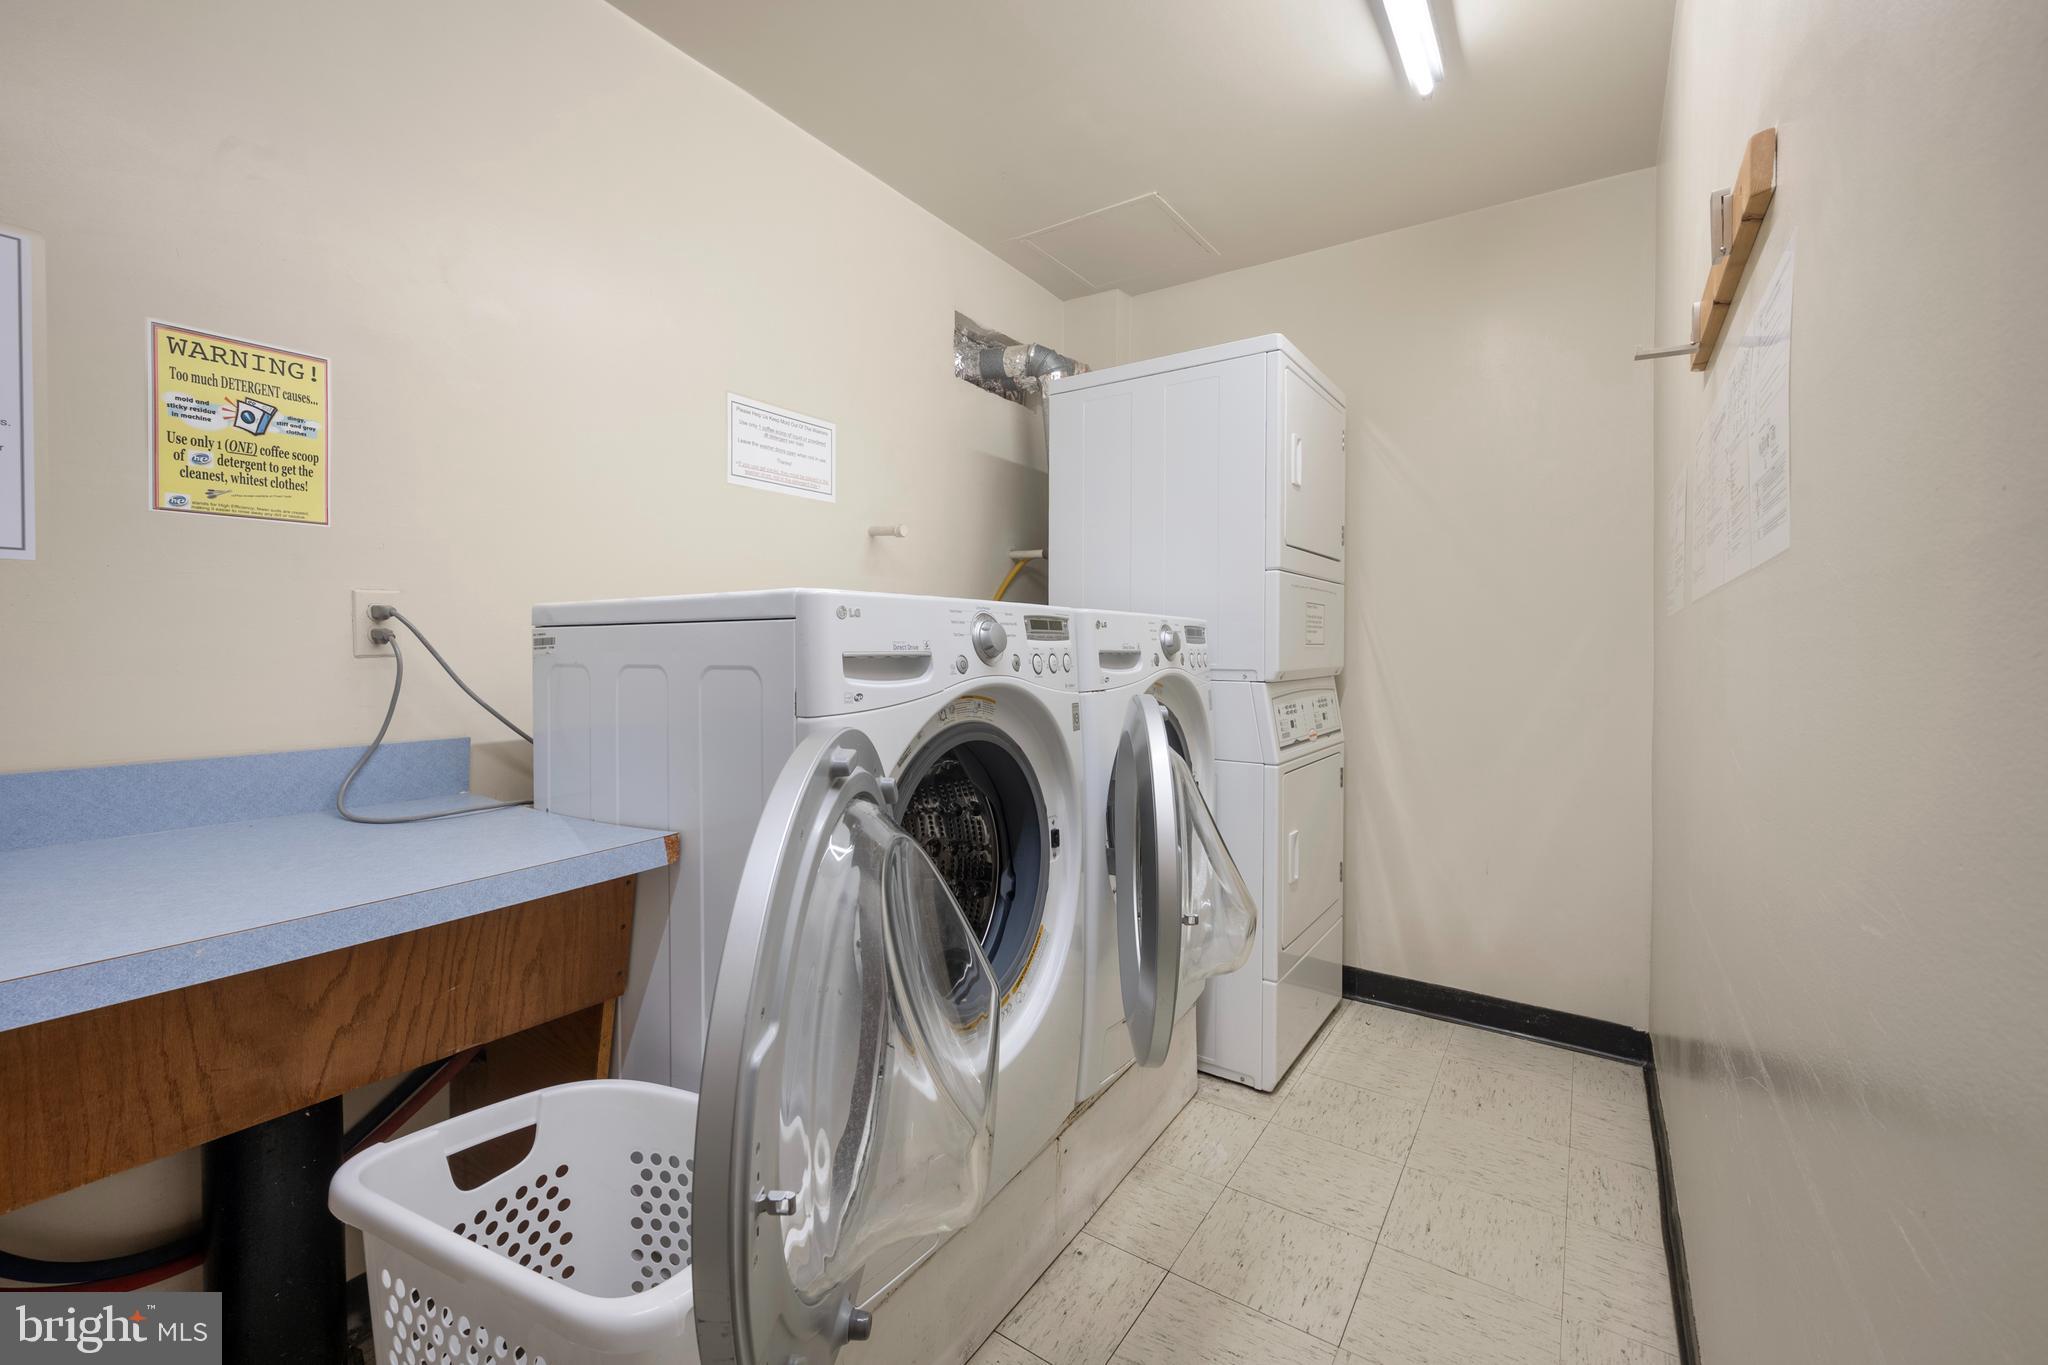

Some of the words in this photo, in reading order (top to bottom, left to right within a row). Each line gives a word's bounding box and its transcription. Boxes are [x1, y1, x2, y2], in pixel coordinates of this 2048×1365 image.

[166, 336, 318, 382] WARNING!
[169, 366, 188, 382] Too
[191, 372, 218, 388] much
[221, 376, 280, 398] DETERGENT
[282, 390, 318, 406] causes...
[166, 402, 187, 411] sticky
[190, 406, 216, 414] residue
[180, 413, 212, 422] machine
[166, 431, 188, 445] Use
[190, 436, 214, 451] only
[217, 441, 222, 450] 1
[225, 438, 258, 456] (ONE)
[260, 446, 289, 460] coffee
[292, 452, 319, 466] scoop
[173, 449, 186, 461] of
[217, 454, 266, 472] detergent
[269, 462, 278, 473] to
[281, 465, 296, 477] get
[298, 465, 314, 478] the
[180, 465, 228, 483] cleanest,
[231, 472, 268, 488] whitest
[270, 478, 308, 492] clothes!
[848, 608, 861, 618] LG
